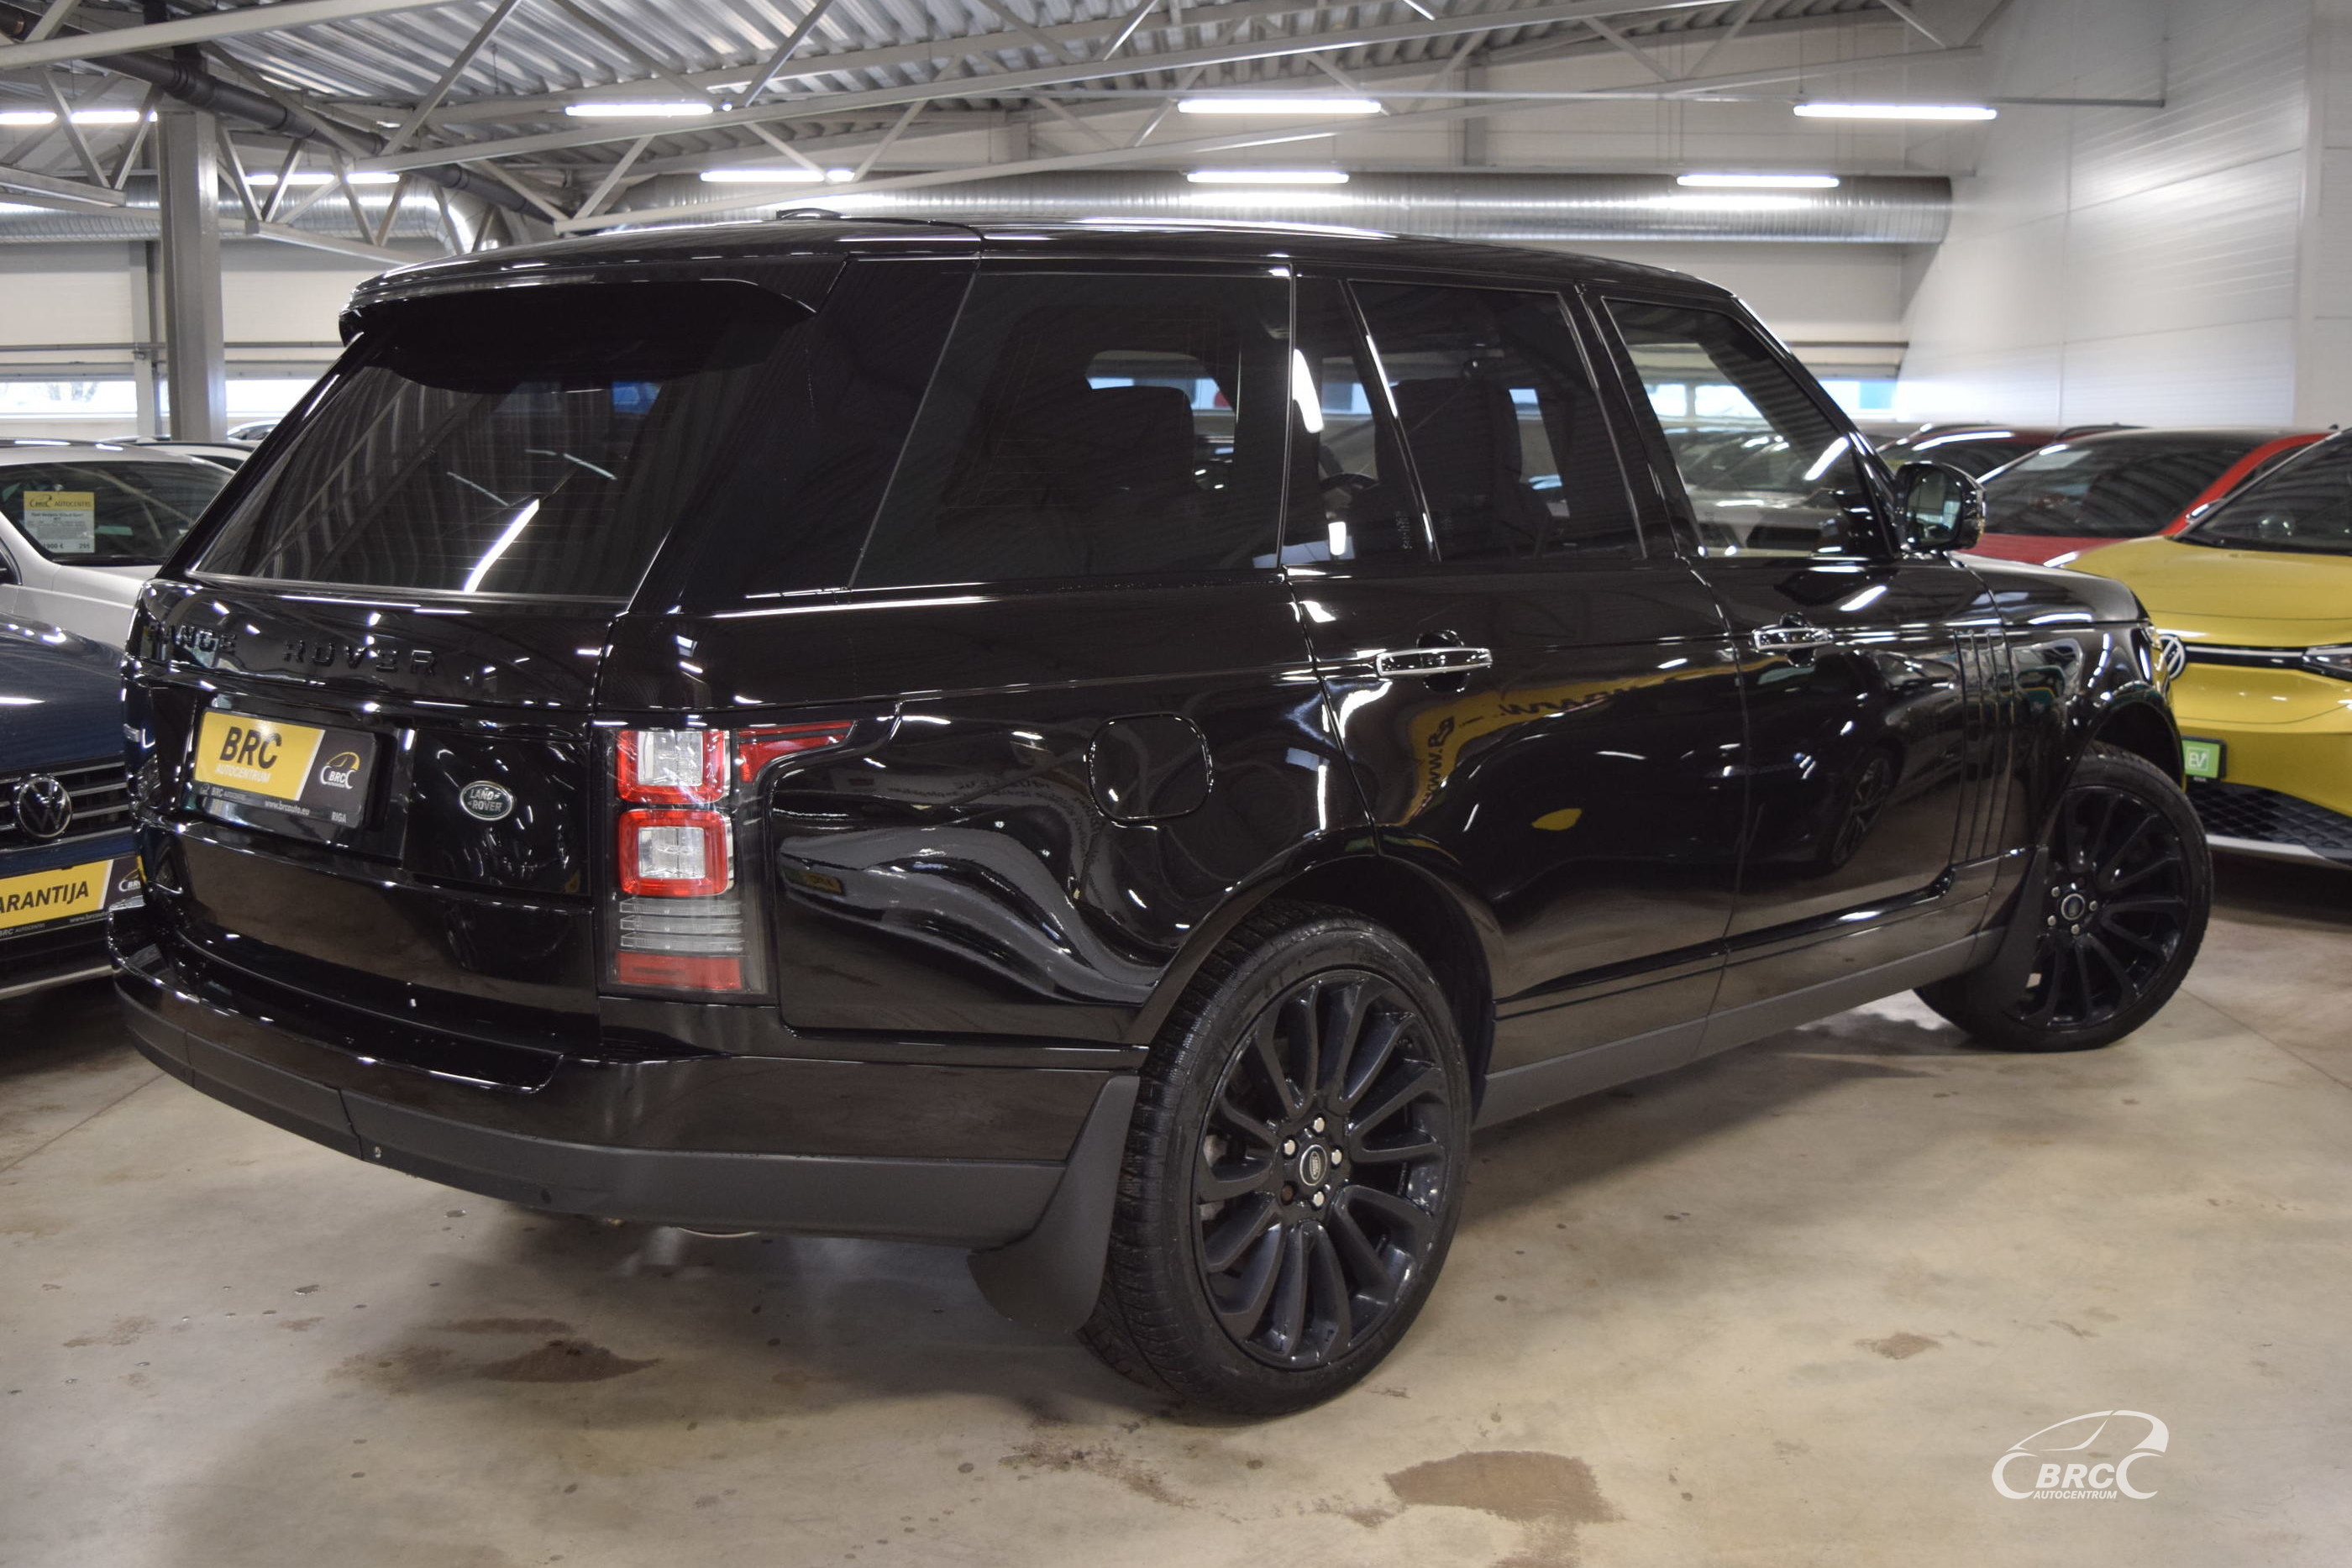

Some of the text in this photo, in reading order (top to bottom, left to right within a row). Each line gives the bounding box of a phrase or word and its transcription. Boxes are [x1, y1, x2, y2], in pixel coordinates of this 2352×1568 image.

[283, 639, 435, 675] ROVER
[219, 726, 281, 769] BRC
[215, 763, 271, 784] AUTOCENTRUM
[470, 788, 495, 800] LAND
[472, 800, 503, 812] ROVER
[331, 810, 347, 824] RIGA
